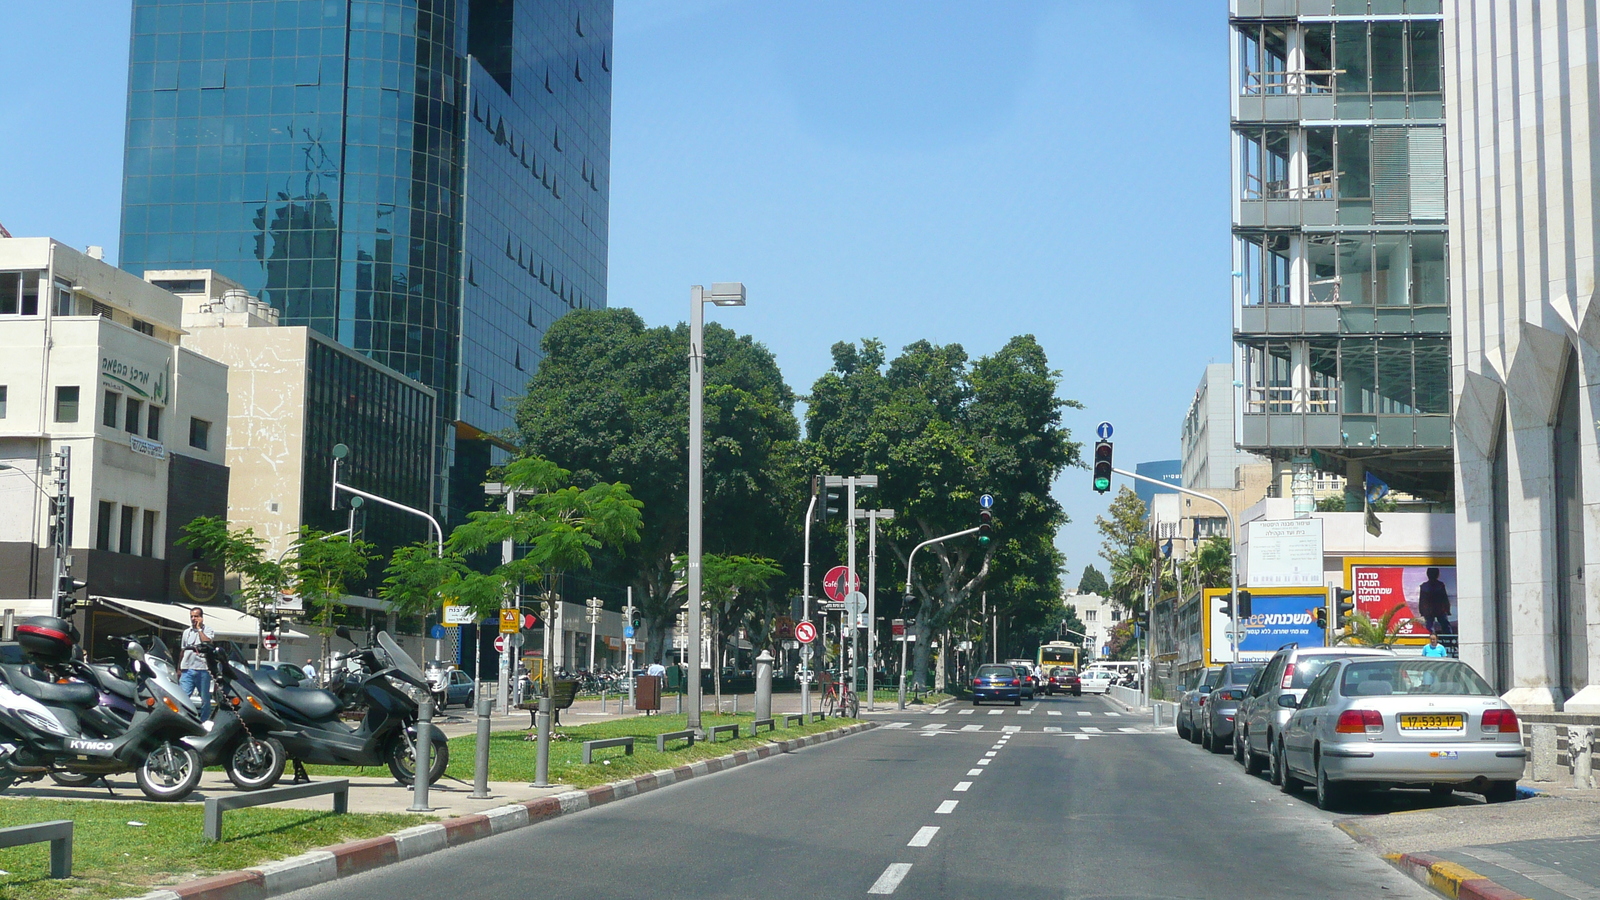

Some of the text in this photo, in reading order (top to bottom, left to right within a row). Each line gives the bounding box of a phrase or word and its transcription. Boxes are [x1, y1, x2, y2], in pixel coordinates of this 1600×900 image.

[102, 358, 150, 384] מרכז ההשמה
[1265, 614, 1312, 625] משכנתא
[70, 740, 114, 750] KYMCO
